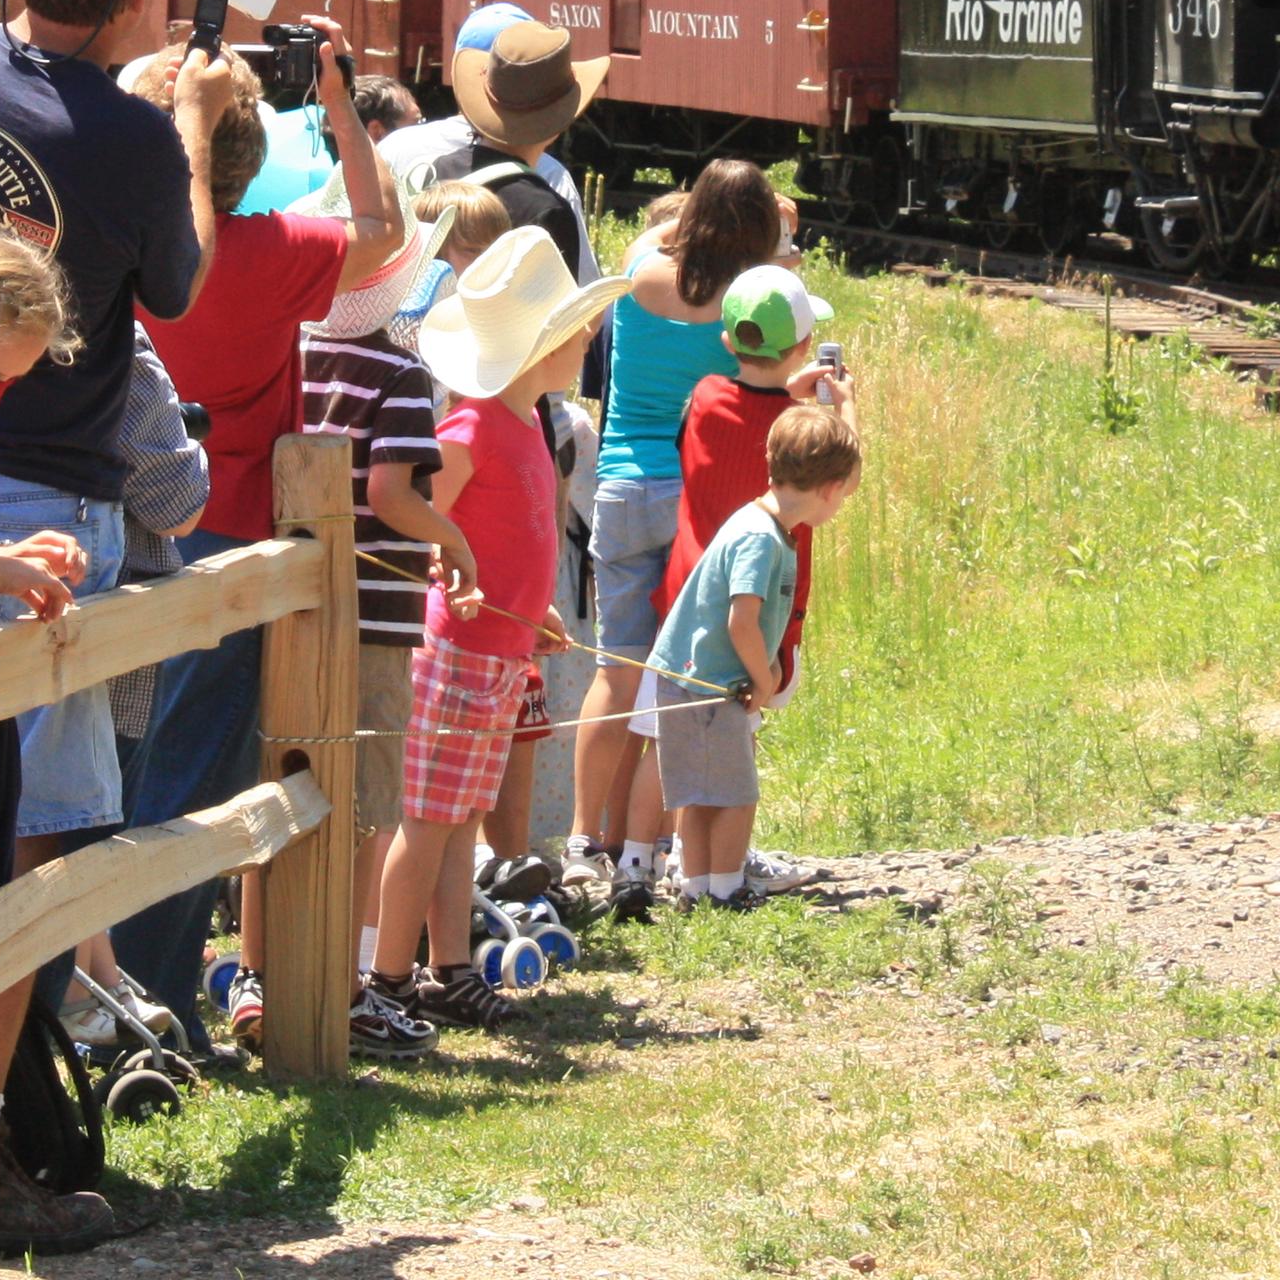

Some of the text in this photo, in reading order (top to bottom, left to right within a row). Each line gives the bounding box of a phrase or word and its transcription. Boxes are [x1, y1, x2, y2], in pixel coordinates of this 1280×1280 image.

[550, 2, 774, 45] SAXON MOUNTAIN 5
